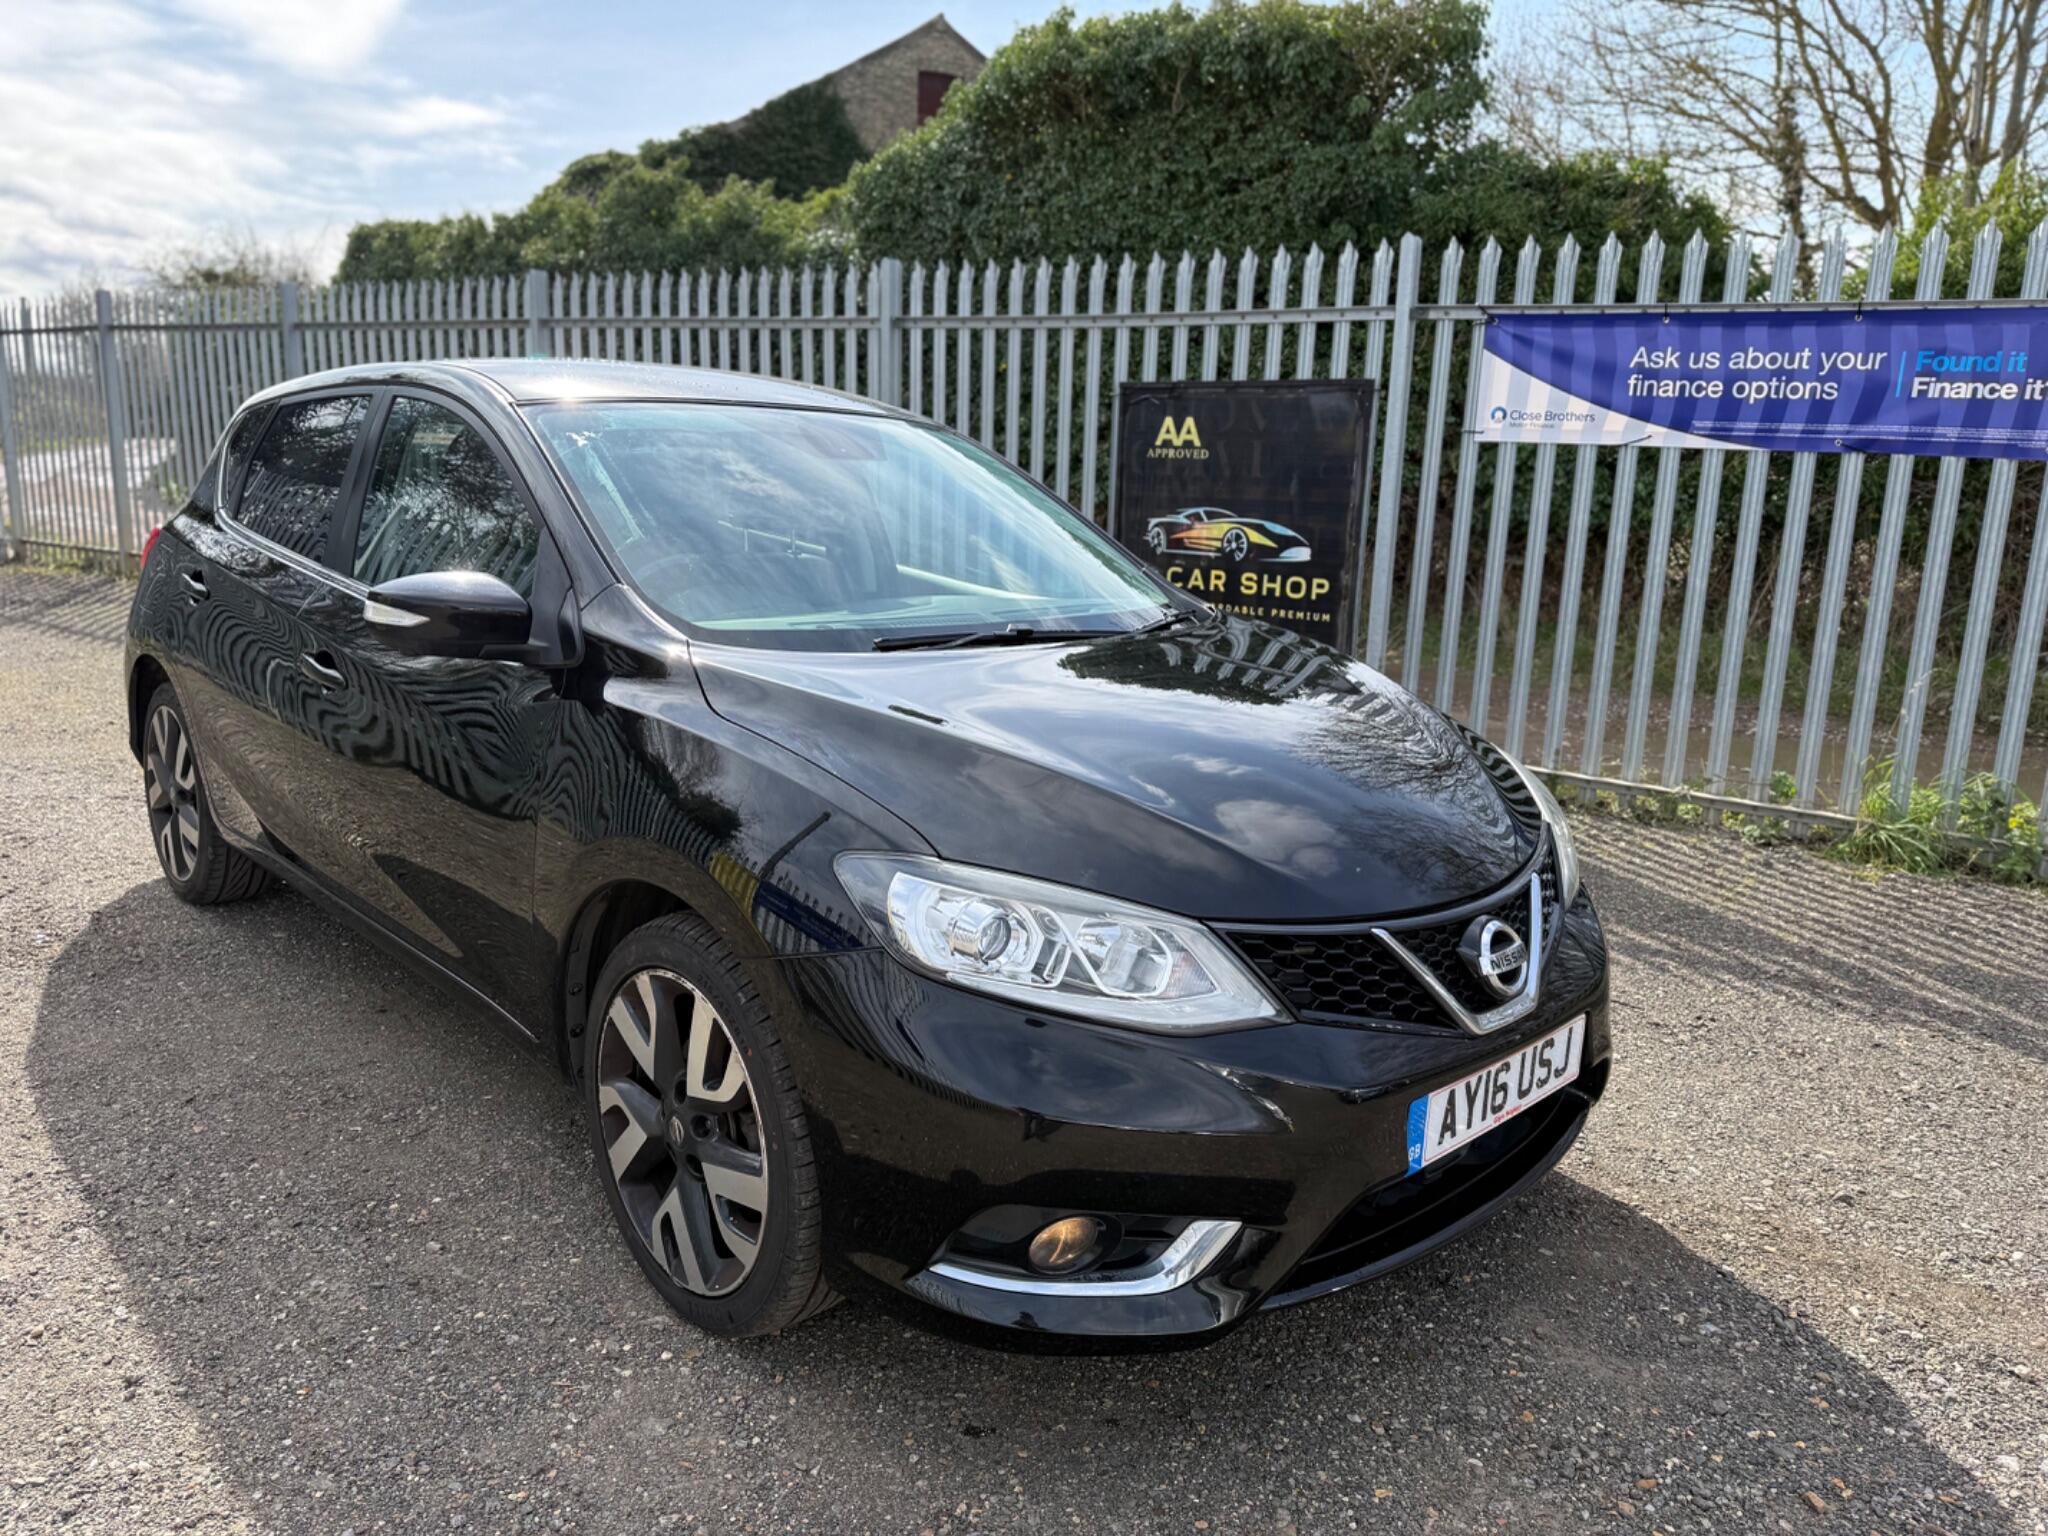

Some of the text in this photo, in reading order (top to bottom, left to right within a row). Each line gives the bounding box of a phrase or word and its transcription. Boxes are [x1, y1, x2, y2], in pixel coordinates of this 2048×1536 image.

[1629, 346, 1888, 376] Ask us about your
[1915, 350, 2029, 373] Found it
[1627, 374, 1839, 404] finance options
[1911, 376, 2019, 400] Finance
[1509, 409, 1596, 422] Close Brothers
[1154, 415, 1202, 447] AA
[1146, 448, 1210, 460] APPROVED
[1166, 565, 1331, 601] CAR SHOP
[1271, 607, 1332, 623] PREMIUM
[1438, 1026, 1574, 1146] AY16 USJ
